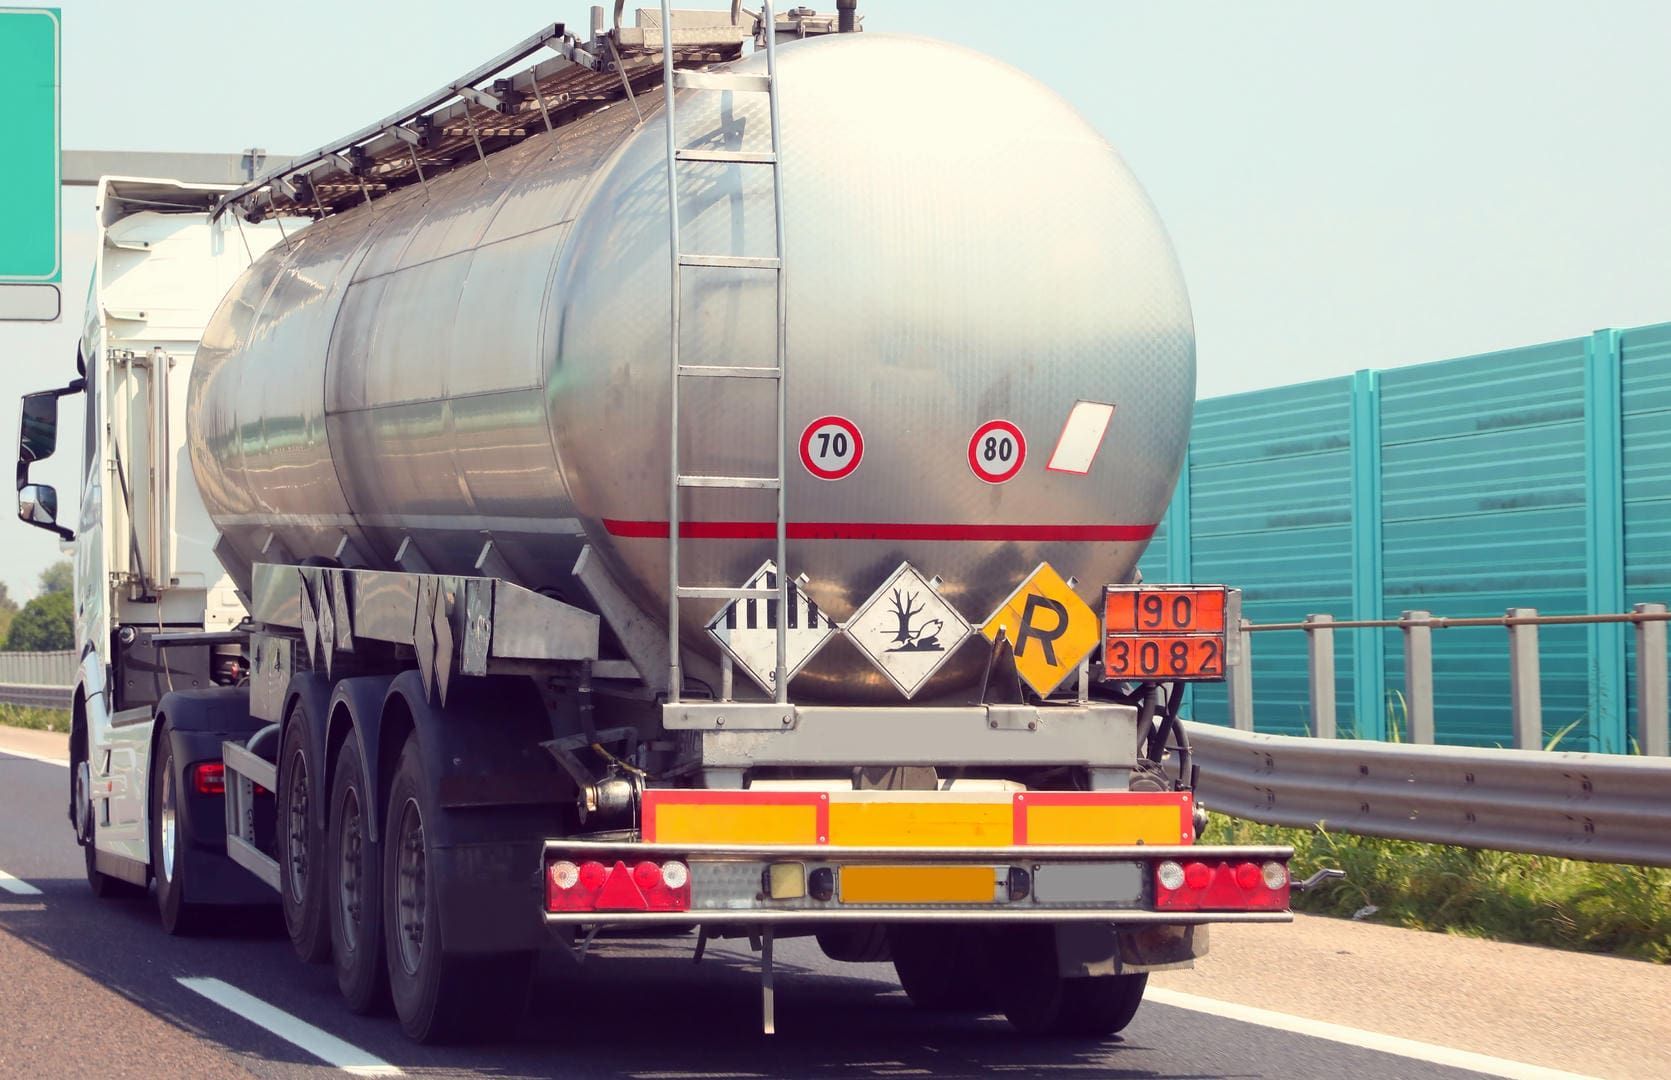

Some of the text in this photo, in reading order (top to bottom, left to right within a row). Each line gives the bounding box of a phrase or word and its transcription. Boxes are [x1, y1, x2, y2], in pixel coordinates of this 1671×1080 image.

[817, 433, 848, 458] 70
[983, 436, 1013, 462] 80
[1143, 594, 1192, 628] 90
[1014, 593, 1069, 667] R
[1111, 640, 1218, 674] 3082
